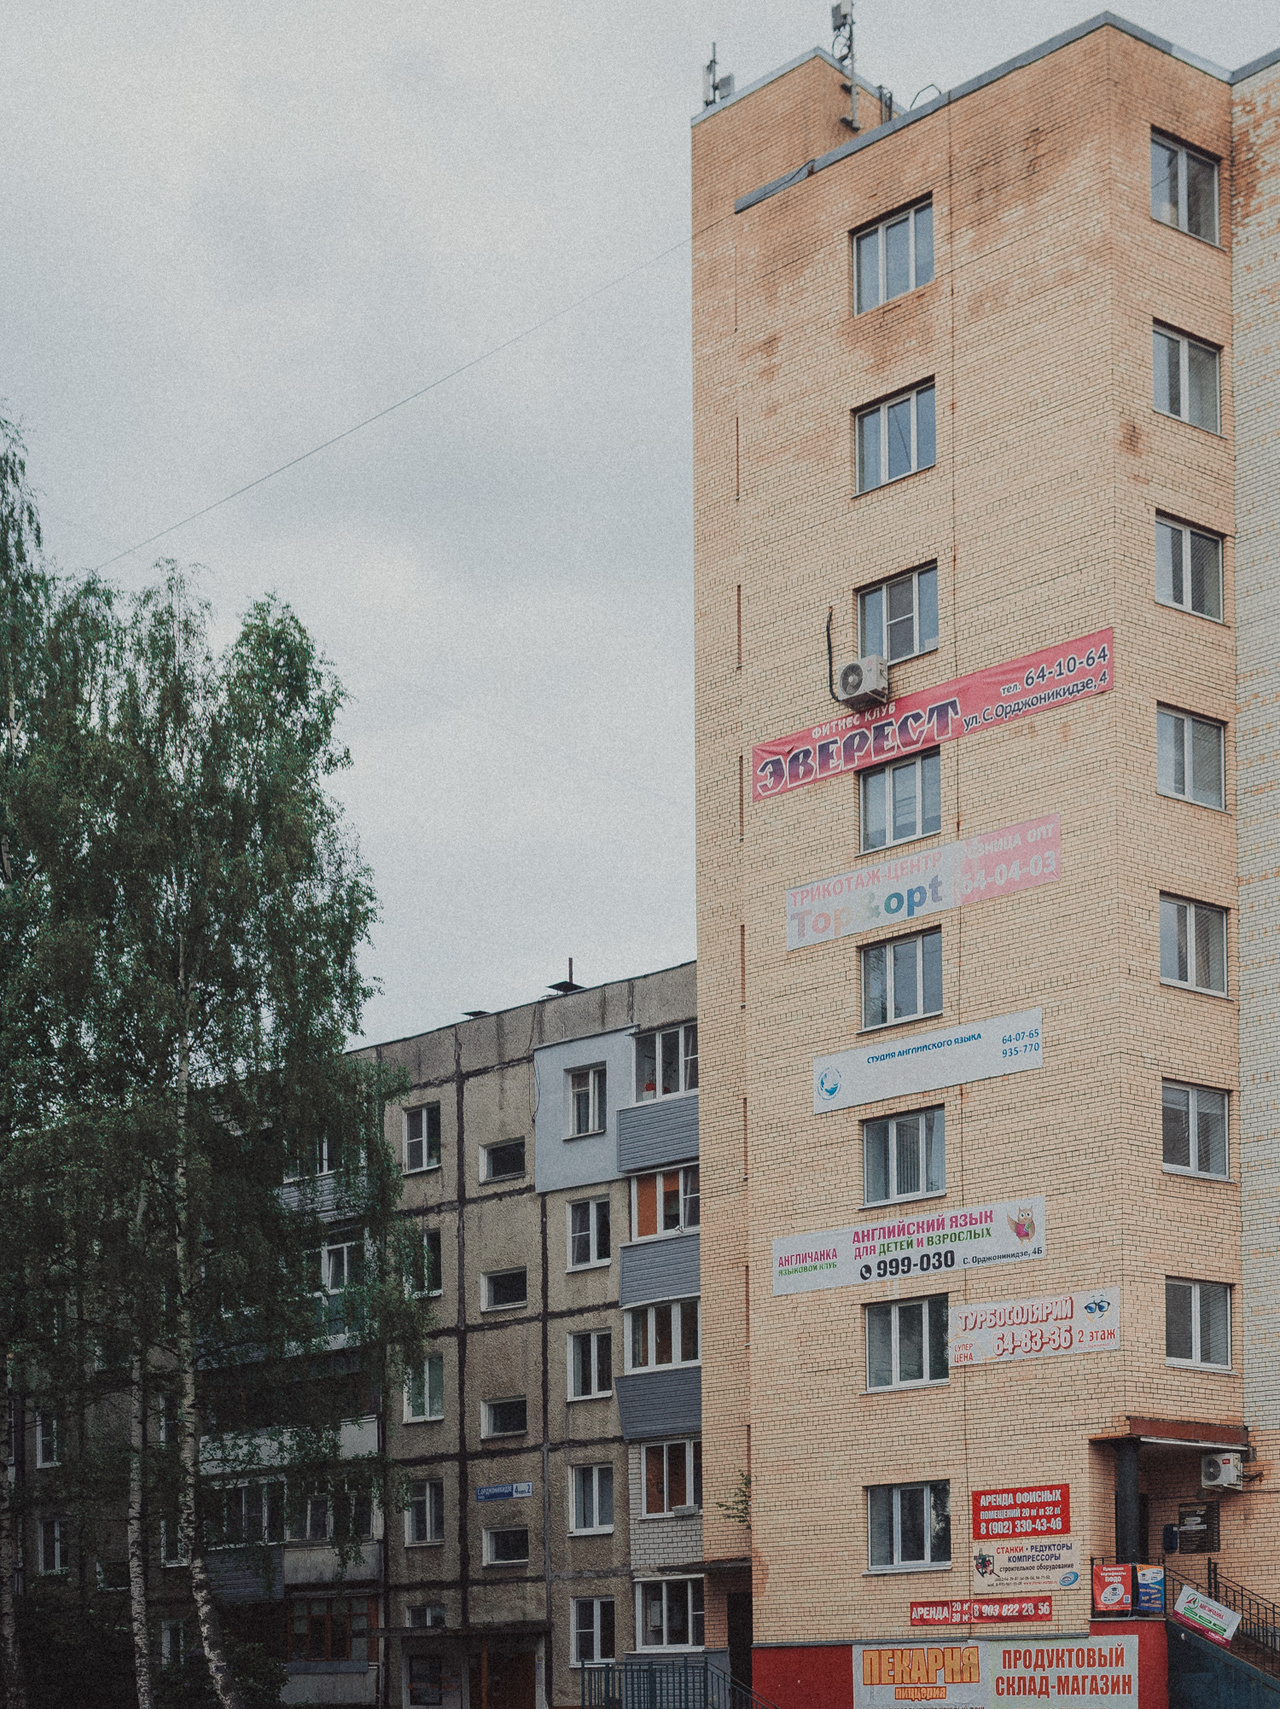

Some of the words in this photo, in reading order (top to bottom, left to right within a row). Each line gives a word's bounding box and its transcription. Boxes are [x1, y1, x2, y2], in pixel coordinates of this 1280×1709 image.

[1001, 683, 1021, 696] тел.
[1024, 644, 1109, 688] 64-10-64
[963, 713, 981, 732] ул.
[995, 677, 1097, 719] Орджоникидзе,
[1099, 670, 1108, 684] 4
[812, 714, 860, 739] ФИТНЕС
[865, 702, 896, 722] КЛУБ
[757, 697, 961, 796] ЭВЕРЕСТ
[964, 833, 1022, 860] ОЗНИЦА
[1027, 823, 1055, 843] ОПТ
[790, 852, 942, 907] ТРИКОТАЖ-ЦЕНТР
[960, 850, 1056, 894] 64-04-03
[1002, 1028, 1039, 1044] 64-07-65
[867, 1051, 896, 1064] СТУДИЯ
[954, 1032, 982, 1045] ЯЗЫКА
[1002, 1042, 1040, 1058] 935-770
[852, 1214, 945, 1244] АНГЛИЙСКИЙ
[950, 1210, 993, 1228] ЯЗЫК
[854, 1245, 876, 1260] ДЛЯ
[878, 1236, 914, 1256] ДЕТЕЙ
[916, 1237, 924, 1248] И
[927, 1227, 992, 1246] ВЗРОСЛЫХ
[778, 1248, 837, 1267] АНГЛИЧАНКА
[876, 1250, 955, 1277] 999-030
[963, 1257, 970, 1265] С.
[778, 1264, 818, 1276] ЯЗЫКОВОЙ
[819, 1262, 837, 1271] КЛУБ
[958, 1296, 1074, 1331] ТУРБОСОЛЯРИЙ
[954, 1343, 974, 1352] СУПЕР
[993, 1325, 1074, 1356] 64-83-36
[1077, 1330, 1085, 1343] 2
[1089, 1328, 1116, 1341] этаж
[953, 1352, 974, 1363] ЦЕНА
[980, 1493, 1014, 1506] АРЕНДА
[1015, 1489, 1061, 1504] ОФИСНЫХ
[980, 1507, 1020, 1519] ПОМЕЩЕНИЙ
[1022, 1508, 1030, 1517] 20
[1045, 1506, 1053, 1515] 32
[980, 1522, 986, 1534] 8
[989, 1521, 1012, 1535] (902)
[1015, 1517, 1062, 1532] 330-43-46
[996, 1546, 1023, 1555] СТАНКИ
[1030, 1543, 1072, 1554] РЕДУКТОРЫ
[1008, 1553, 1061, 1563] КОМПРЕССОРЫ
[1000, 1565, 1035, 1573] строительное
[1036, 1563, 1074, 1571] оборудование
[912, 1606, 949, 1620] АРЕНДА
[952, 1602, 961, 1611] 20
[951, 1613, 960, 1622] 30
[973, 1604, 979, 1616] 8
[982, 1604, 999, 1616] 903
[1001, 1604, 1019, 1616] 822
[1022, 1602, 1035, 1615] 28
[1038, 1602, 1050, 1614] 56
[862, 1646, 980, 1685] ПЕКАРНЯ
[1002, 1642, 1124, 1672] ПРОДУКТОВЫЙ
[895, 1686, 947, 1702] пиццерия
[995, 1674, 1132, 1699] СКЛАД-МАГАЗИН
